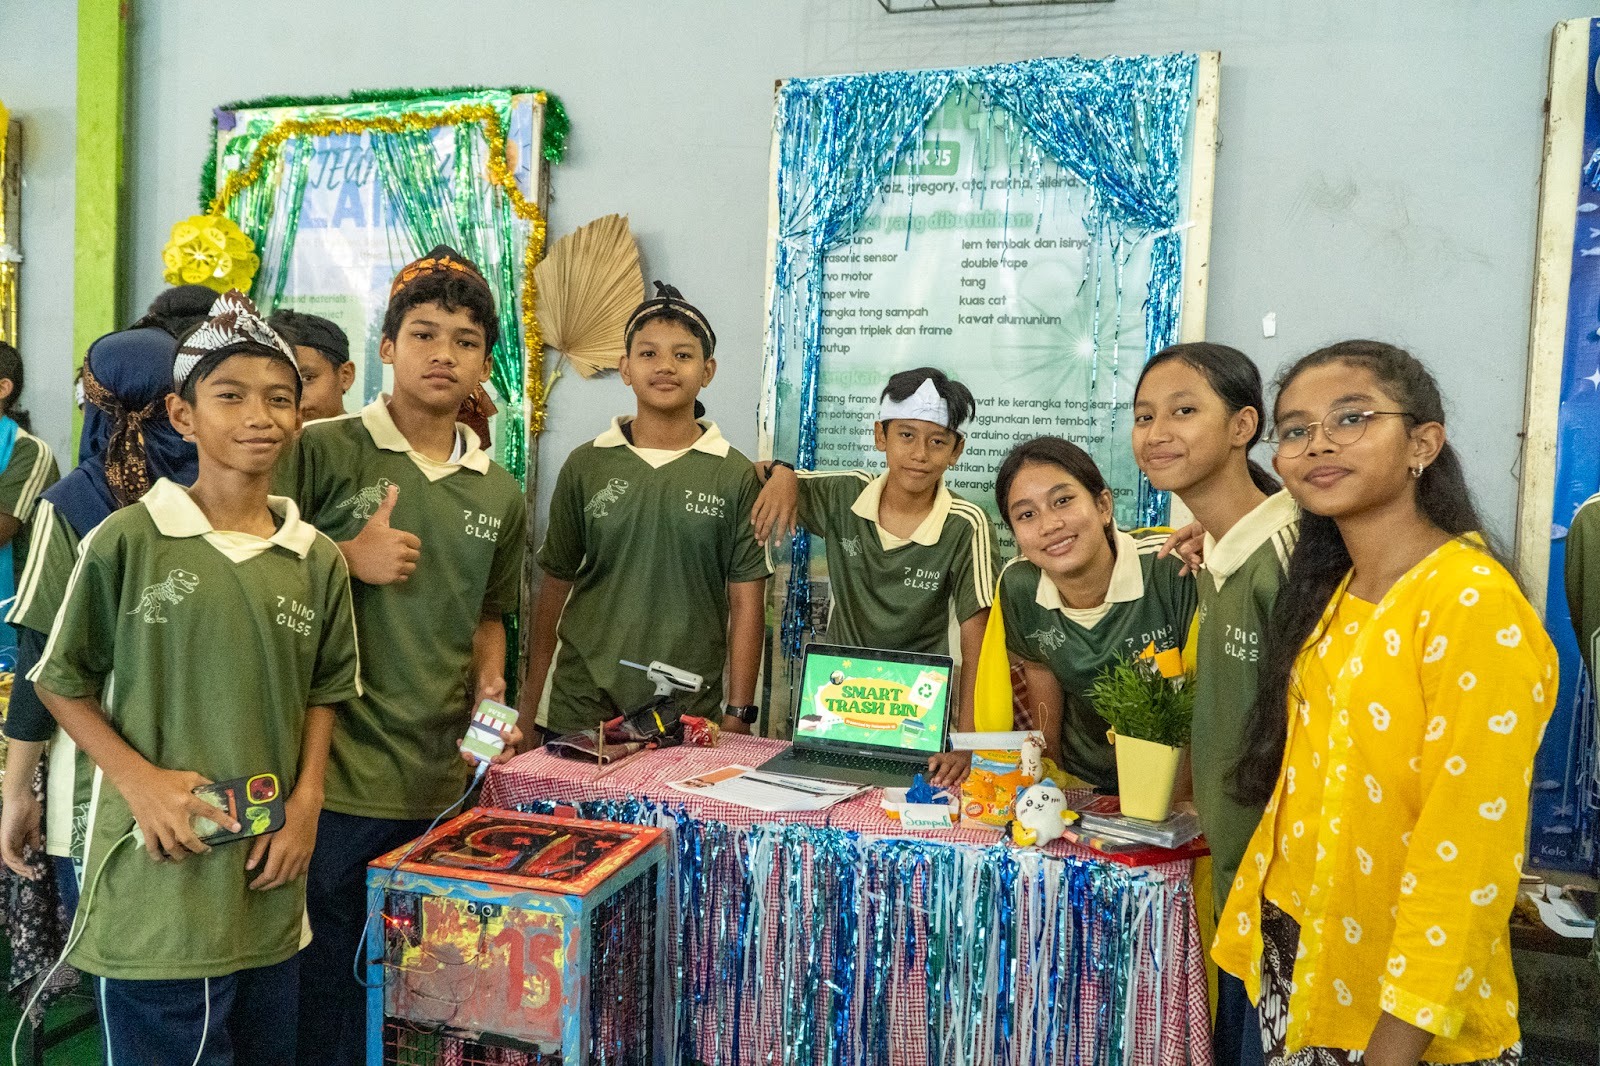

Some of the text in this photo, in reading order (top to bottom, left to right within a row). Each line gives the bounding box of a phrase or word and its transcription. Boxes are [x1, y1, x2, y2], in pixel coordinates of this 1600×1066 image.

[962, 239, 983, 249] lem
[986, 239, 1030, 249] tembak
[1034, 238, 1057, 248] dan
[864, 253, 898, 263] sensor
[961, 258, 1028, 270] double tape
[821, 271, 873, 281] rvo motor
[961, 277, 986, 290] tang
[821, 289, 870, 301] mper wire
[959, 295, 1007, 306] kuas cat
[820, 307, 929, 320] rangka tong sampah
[958, 314, 1062, 325] kawat alumunium
[820, 325, 953, 338] tongan triplek dan frame
[820, 343, 851, 355] nutup
[817, 394, 845, 405] asang
[848, 394, 877, 403] frame
[975, 397, 995, 407] wat
[998, 397, 1010, 407] ke
[1013, 398, 1061, 411] kerangka
[1064, 399, 1088, 411] tong
[830, 411, 875, 422] potongan
[974, 414, 1029, 426] nggunakan
[1032, 415, 1052, 425] lem
[1056, 416, 1097, 426] tembak
[849, 427, 875, 435] skem
[971, 430, 1010, 440] arduino
[1012, 431, 1033, 441] dan
[1067, 433, 1105, 445] jumper
[837, 442, 876, 452] software
[966, 447, 986, 456] dan
[988, 447, 1009, 457] mul
[842, 457, 864, 468] code
[867, 458, 878, 468] ke
[948, 462, 984, 473] astikan
[987, 463, 1001, 473] be
[954, 479, 997, 493] kerangk
[685, 489, 726, 507] 7 DINO
[1112, 488, 1134, 499] gan
[685, 502, 725, 519] CLASS
[463, 509, 502, 530] 7 DIN
[465, 524, 499, 543] CLAS
[998, 537, 1016, 548] tak
[904, 566, 940, 580] 7 DINO
[903, 577, 939, 591] CLASS
[276, 595, 316, 622] 7 DINO
[1225, 624, 1259, 645] 7 DIO
[1124, 637, 1135, 648] 7
[841, 685, 904, 702] SMART
[825, 698, 919, 718] TRASH BIN
[904, 809, 952, 829] Sampah
[495, 928, 562, 1018] 15
